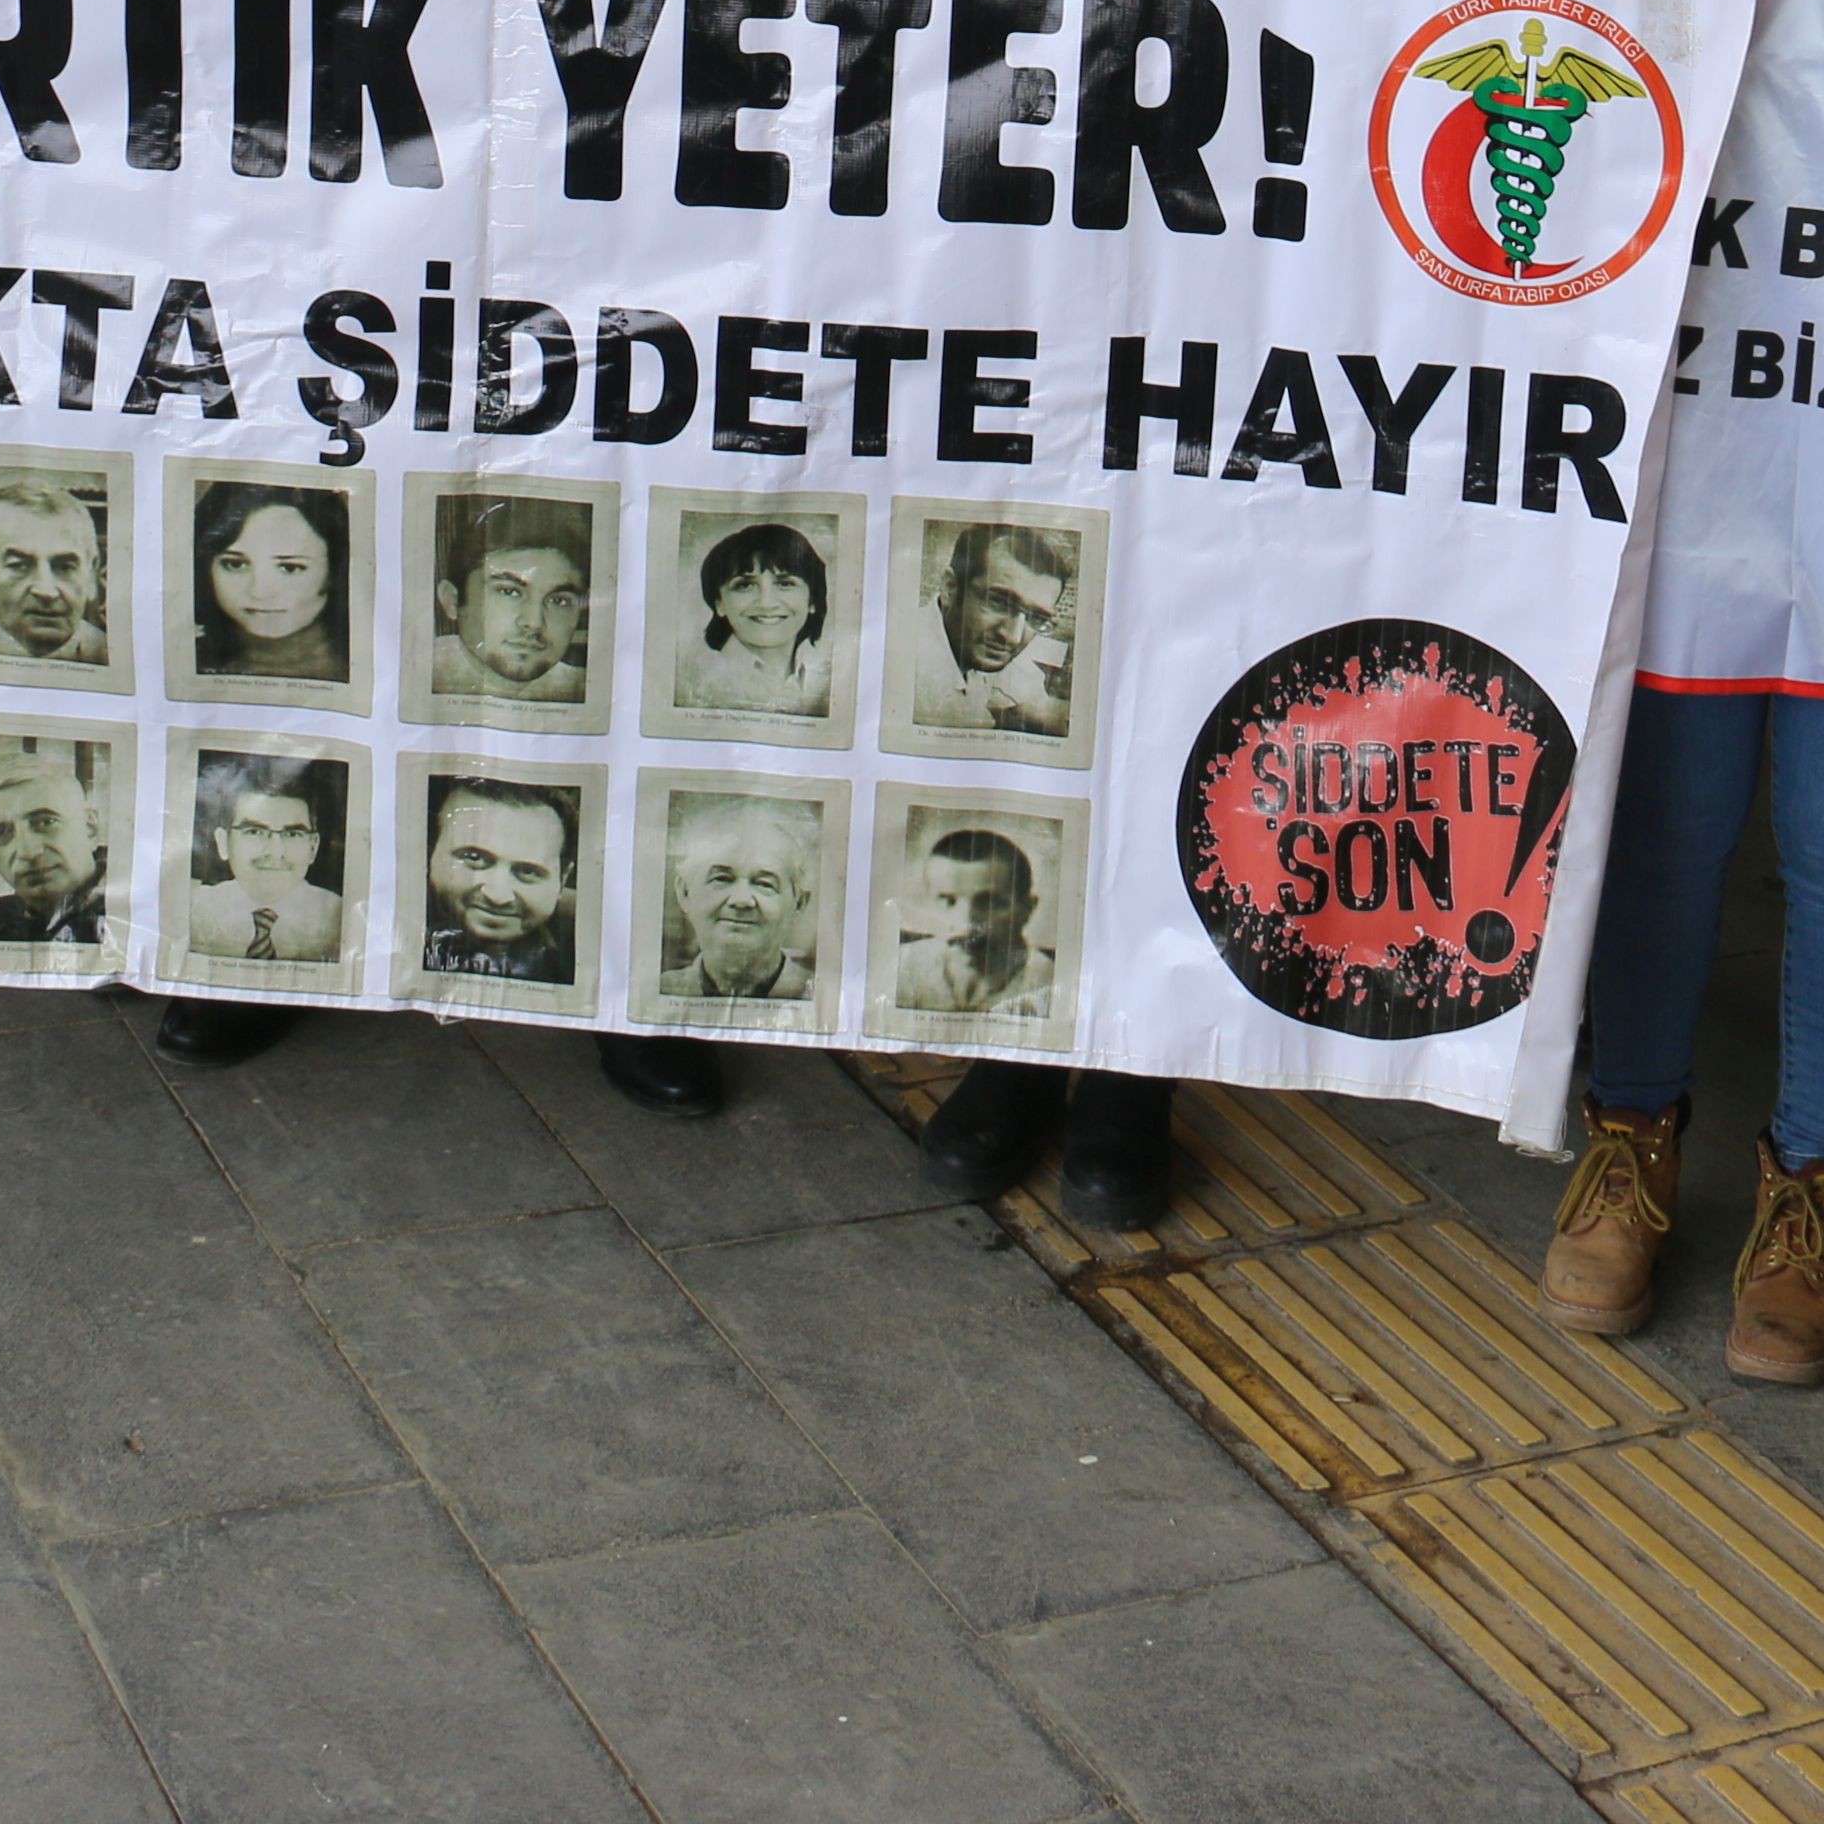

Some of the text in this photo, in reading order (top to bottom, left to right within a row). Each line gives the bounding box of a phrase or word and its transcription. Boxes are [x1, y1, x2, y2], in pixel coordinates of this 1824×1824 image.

[1506, 284, 1555, 303] TABİP
[1558, 267, 1610, 298] ODASI
[298, 260, 1038, 468] ŞİDDETE
[1102, 334, 1630, 525] HAYIR
[1250, 725, 1522, 830] ŞİDDETE
